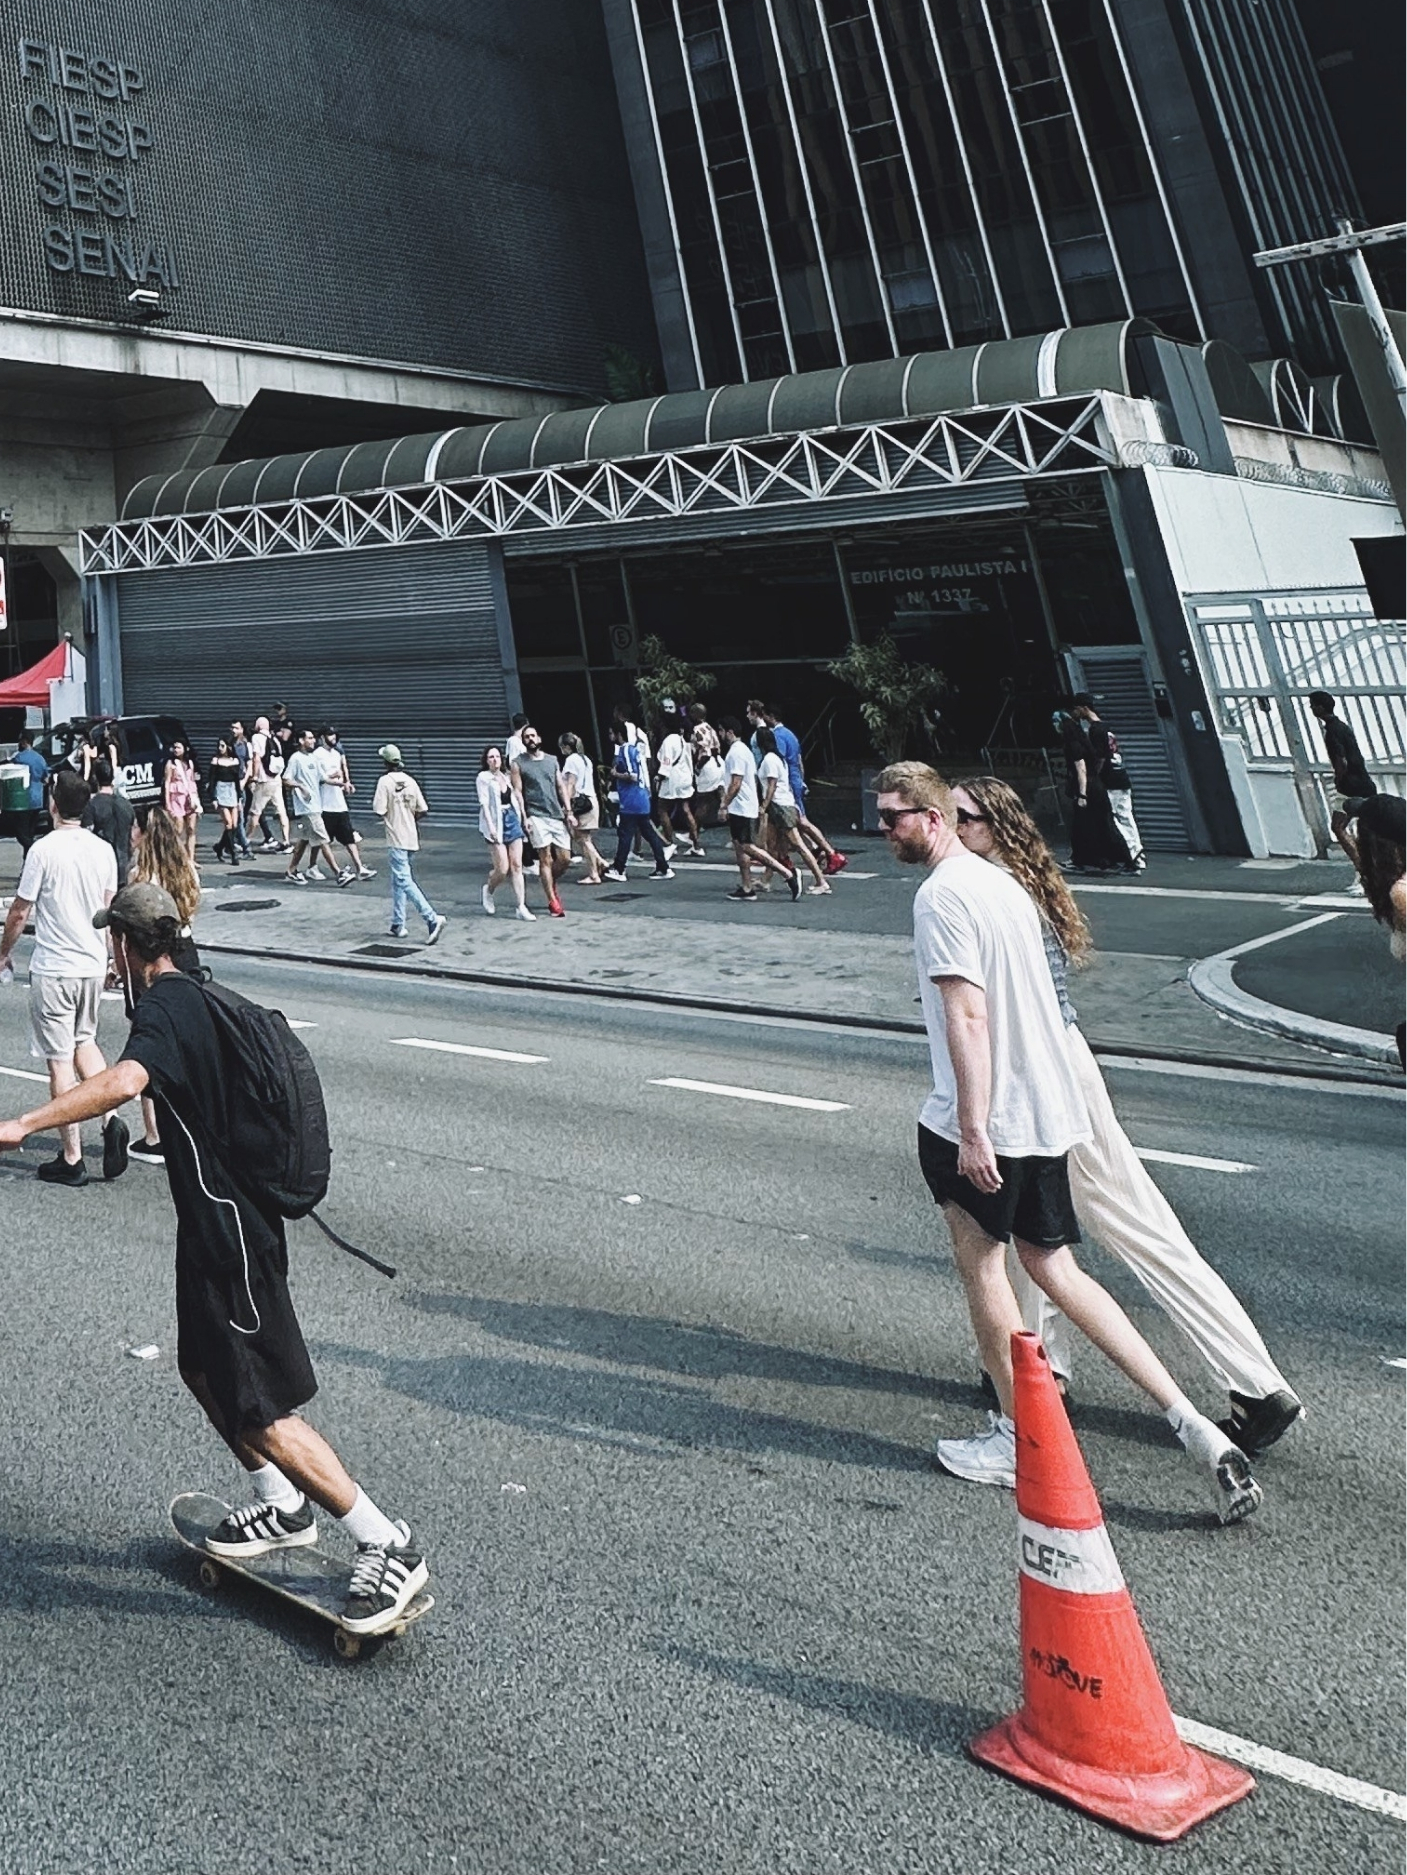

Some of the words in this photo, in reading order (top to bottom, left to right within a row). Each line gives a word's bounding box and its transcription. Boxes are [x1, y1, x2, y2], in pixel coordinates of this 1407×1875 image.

[19, 37, 143, 102] FIESP
[25, 98, 154, 160] CIESP
[37, 161, 136, 218] SESI
[44, 225, 179, 287] SENAI
[930, 561, 1016, 579] PAULISTA
[931, 588, 972, 604] 1337
[114, 762, 154, 786] CM
